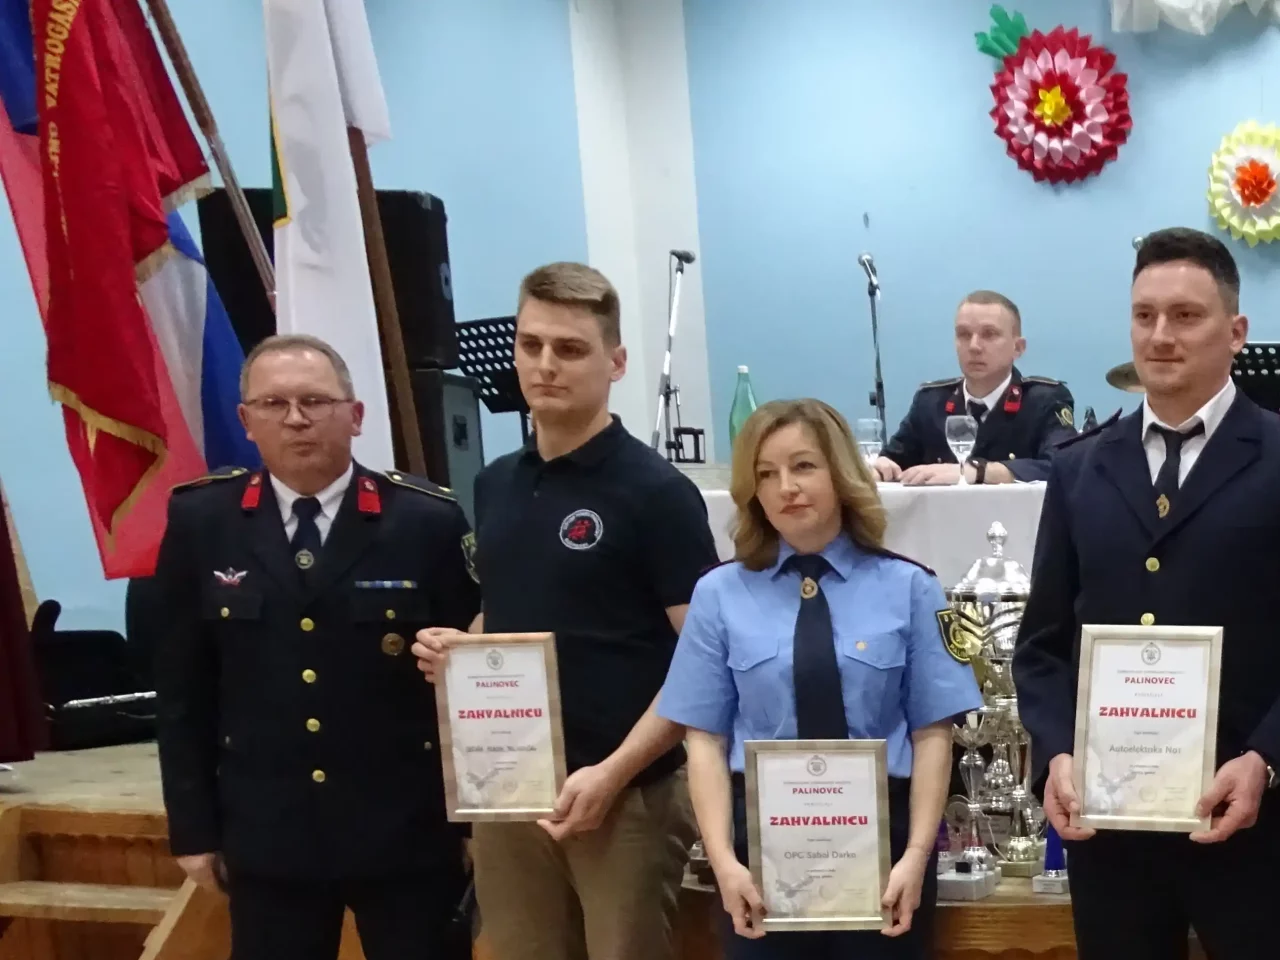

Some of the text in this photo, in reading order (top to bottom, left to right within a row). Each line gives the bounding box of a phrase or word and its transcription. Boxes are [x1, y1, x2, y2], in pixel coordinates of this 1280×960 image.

[475, 680, 520, 688] PALINOVEC
[1124, 676, 1176, 685] PALINOVEC
[458, 708, 543, 720] ZAHVALNICU
[1099, 706, 1197, 719] ZAHVALNICU
[792, 786, 844, 795] PALINOVEC
[769, 816, 868, 826] ZAHVALNICU
